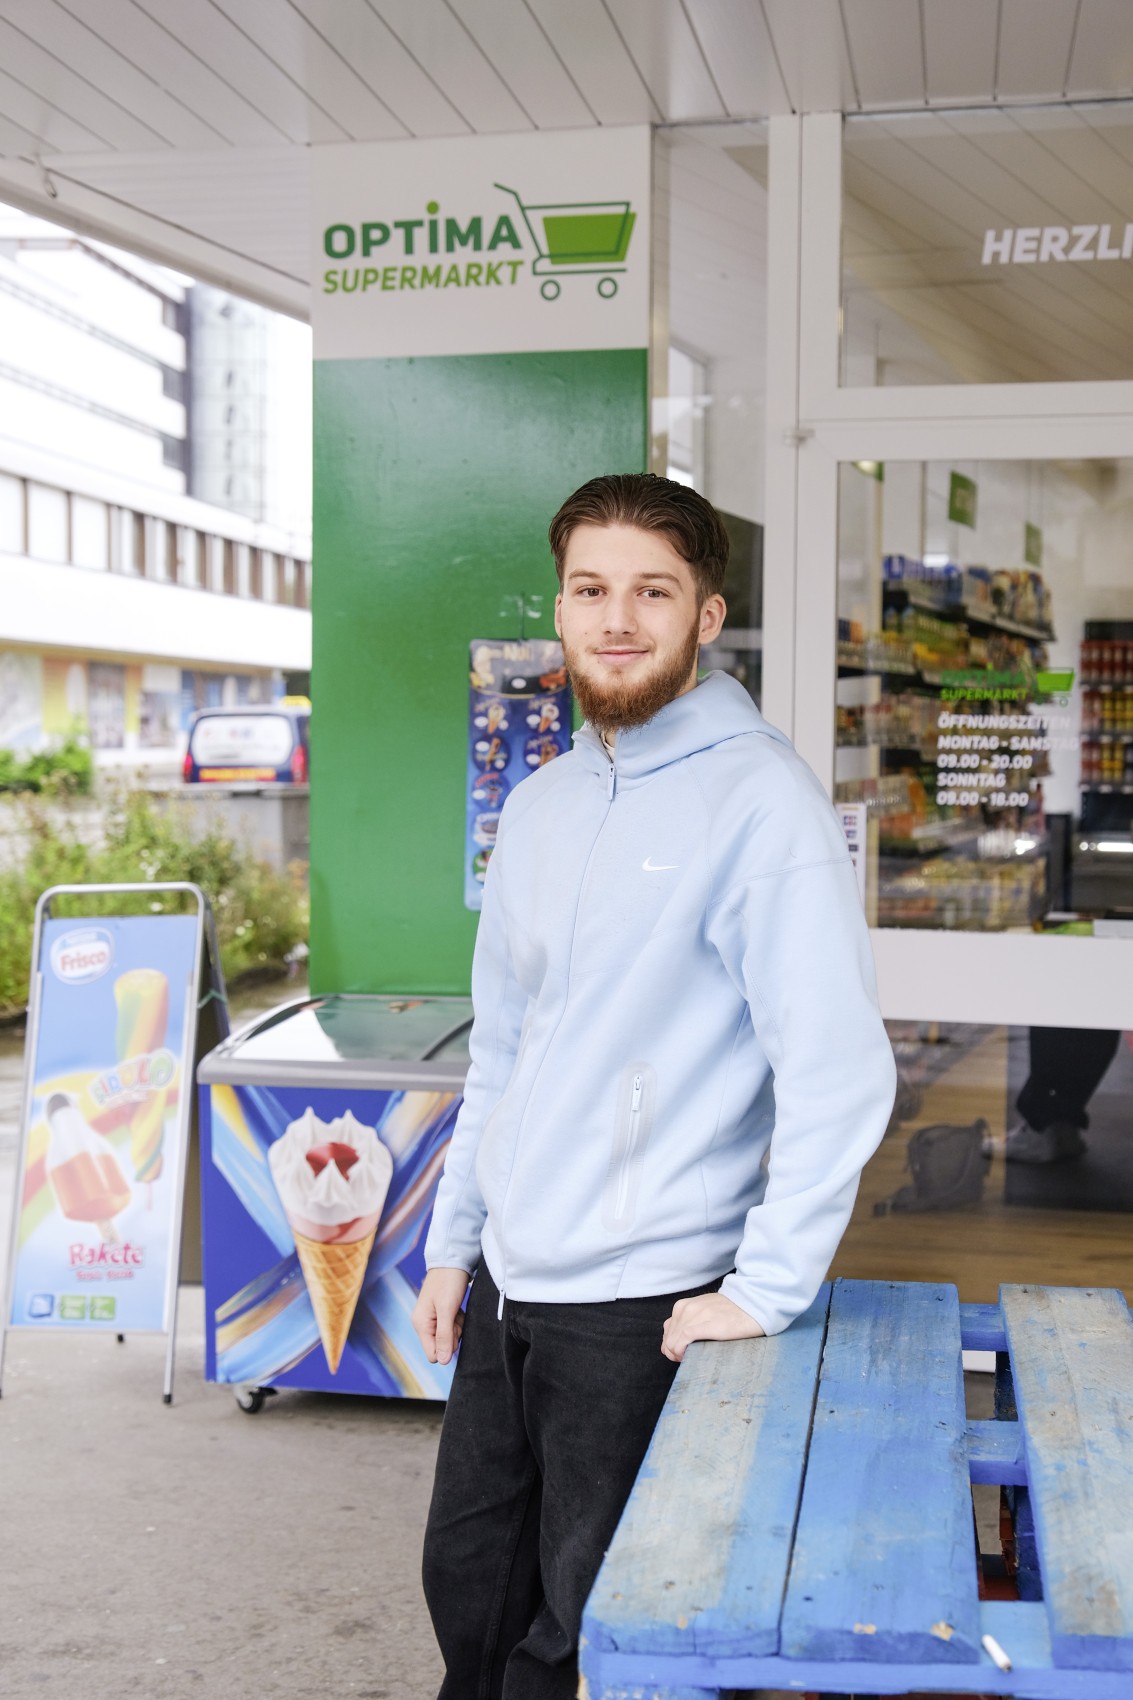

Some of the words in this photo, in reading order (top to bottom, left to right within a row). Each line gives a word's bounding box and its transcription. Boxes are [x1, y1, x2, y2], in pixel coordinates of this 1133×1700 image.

[324, 201, 523, 259] OPTIMA
[981, 223, 1133, 266] HERZLI
[323, 260, 524, 295] SUPERMARKT
[940, 687, 1028, 701] SUPERMARKT
[937, 711, 1071, 729] ÖFFNUNGSZEITEN
[937, 735, 1000, 750] MONTAG
[1010, 736, 1078, 751] SAMSTAG
[990, 754, 1032, 769] 20.00
[937, 772, 1006, 787] SONNTAG
[61, 950, 106, 971] Frisco
